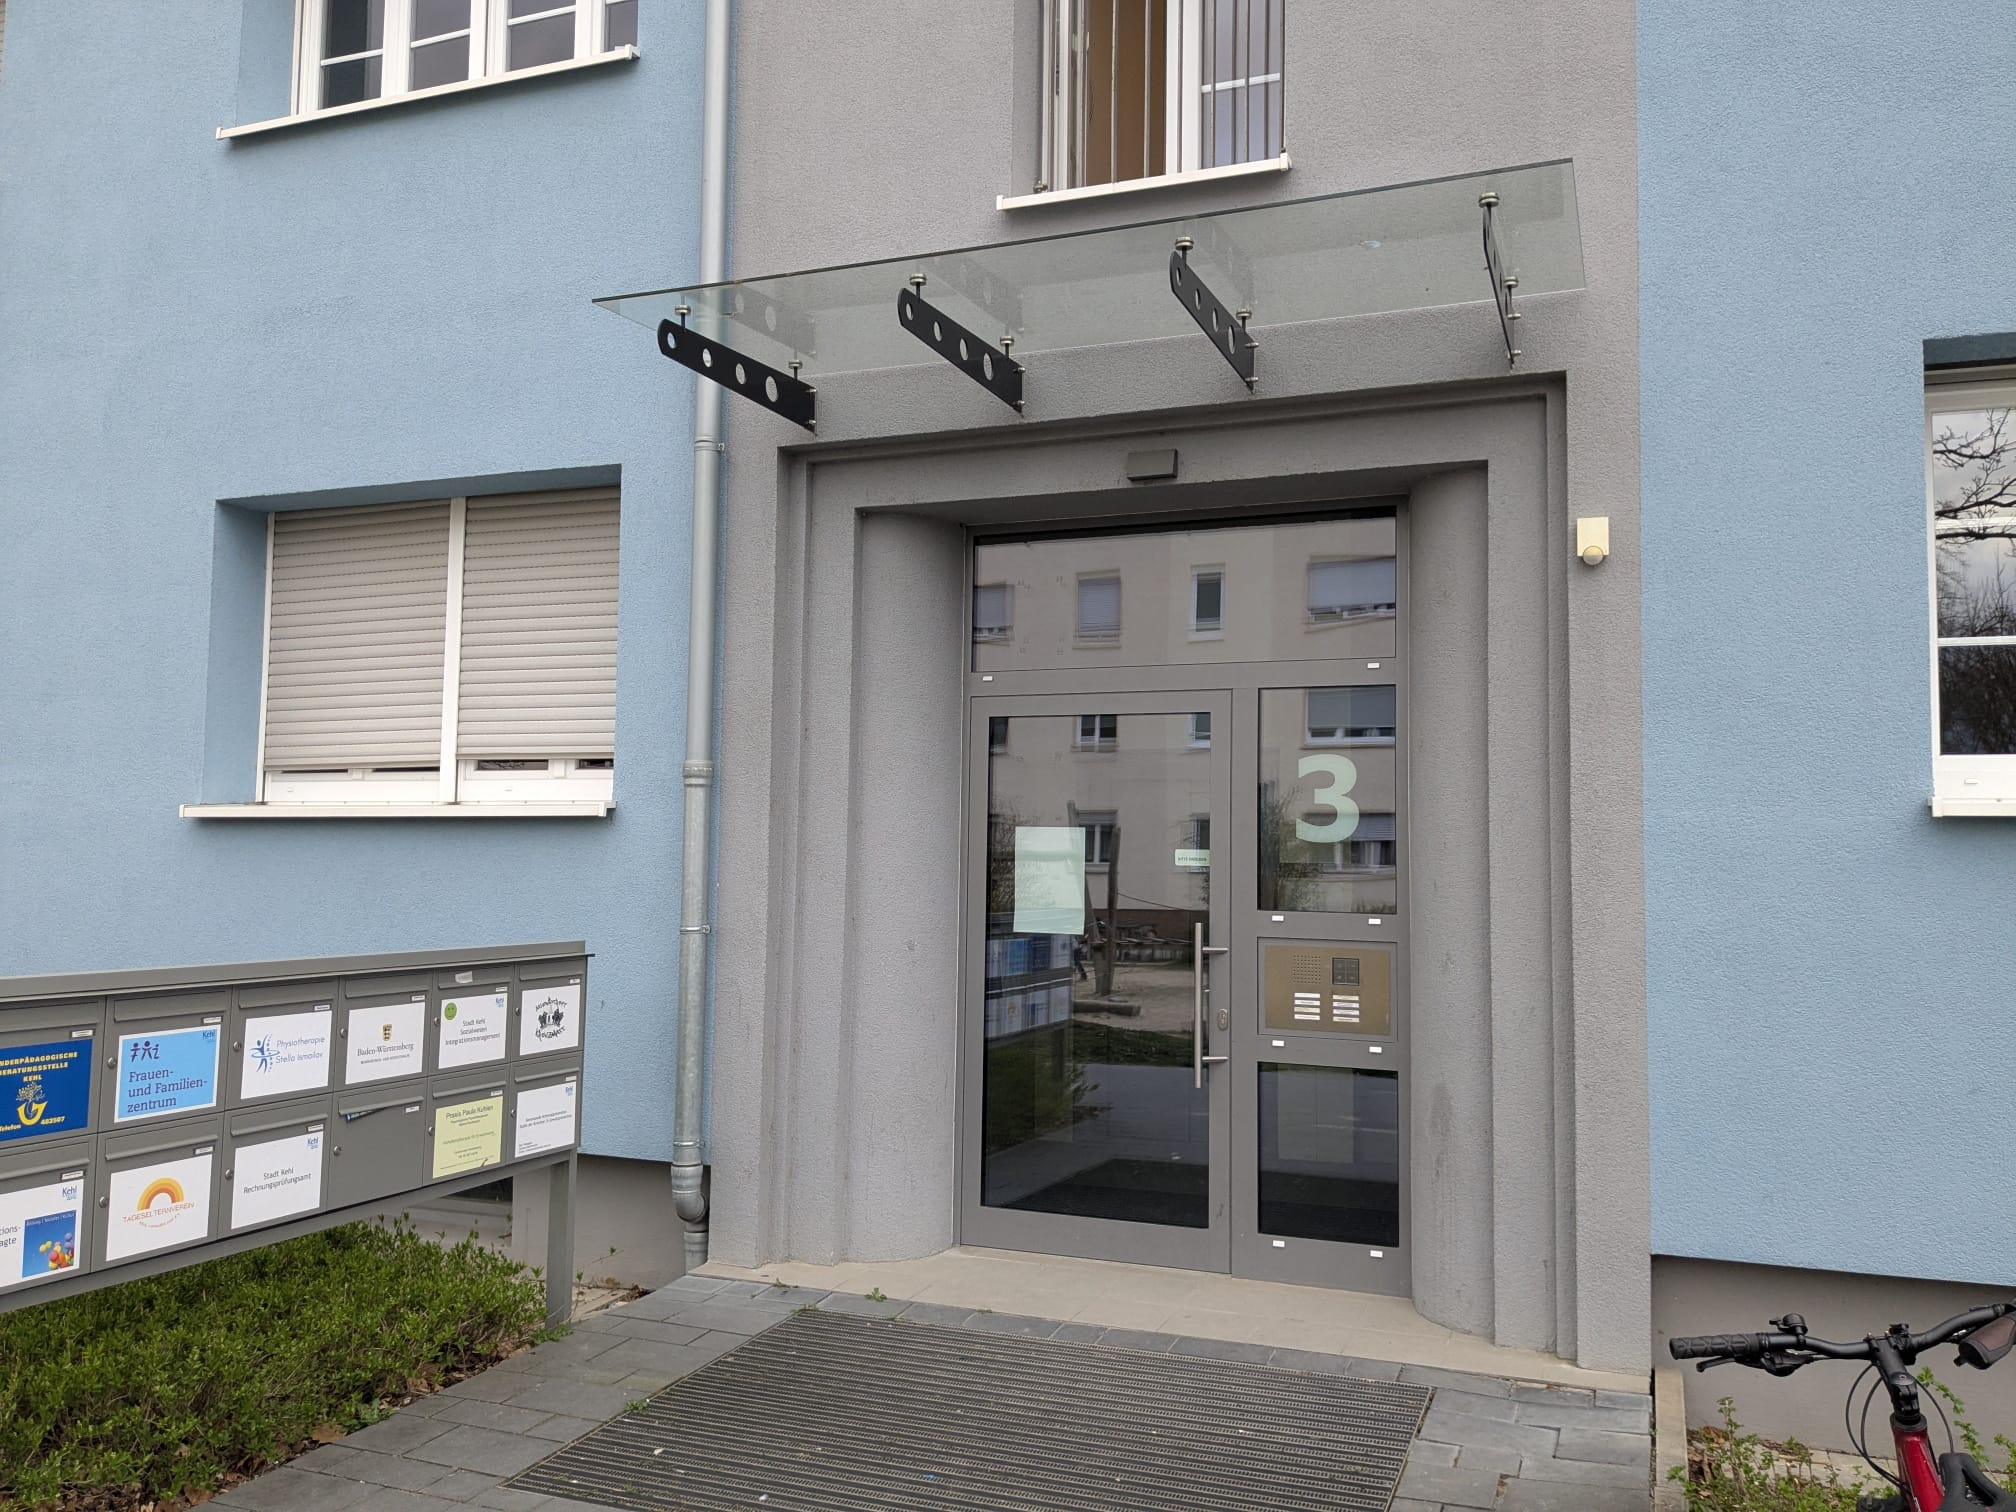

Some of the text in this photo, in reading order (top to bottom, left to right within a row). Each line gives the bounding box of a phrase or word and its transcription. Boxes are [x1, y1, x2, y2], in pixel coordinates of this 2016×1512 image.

[1295, 753, 1360, 843] 3
[276, 1036, 325, 1048] Physiotherapie
[357, 1042, 414, 1056] Baden-Württemberg
[276, 1054, 295, 1063] Stella
[23, 1074, 42, 1082] KEHL
[129, 1069, 174, 1083] Frauen-
[128, 1078, 208, 1098] und Familien-
[127, 1097, 177, 1113] zentrum
[263, 1167, 294, 1180] Stadt Kehl
[243, 1173, 311, 1194] Rechnungsprüfungsamt
[62, 1185, 77, 1197] Kehl
[122, 1201, 195, 1223] TAGESELTERNVEREIN
